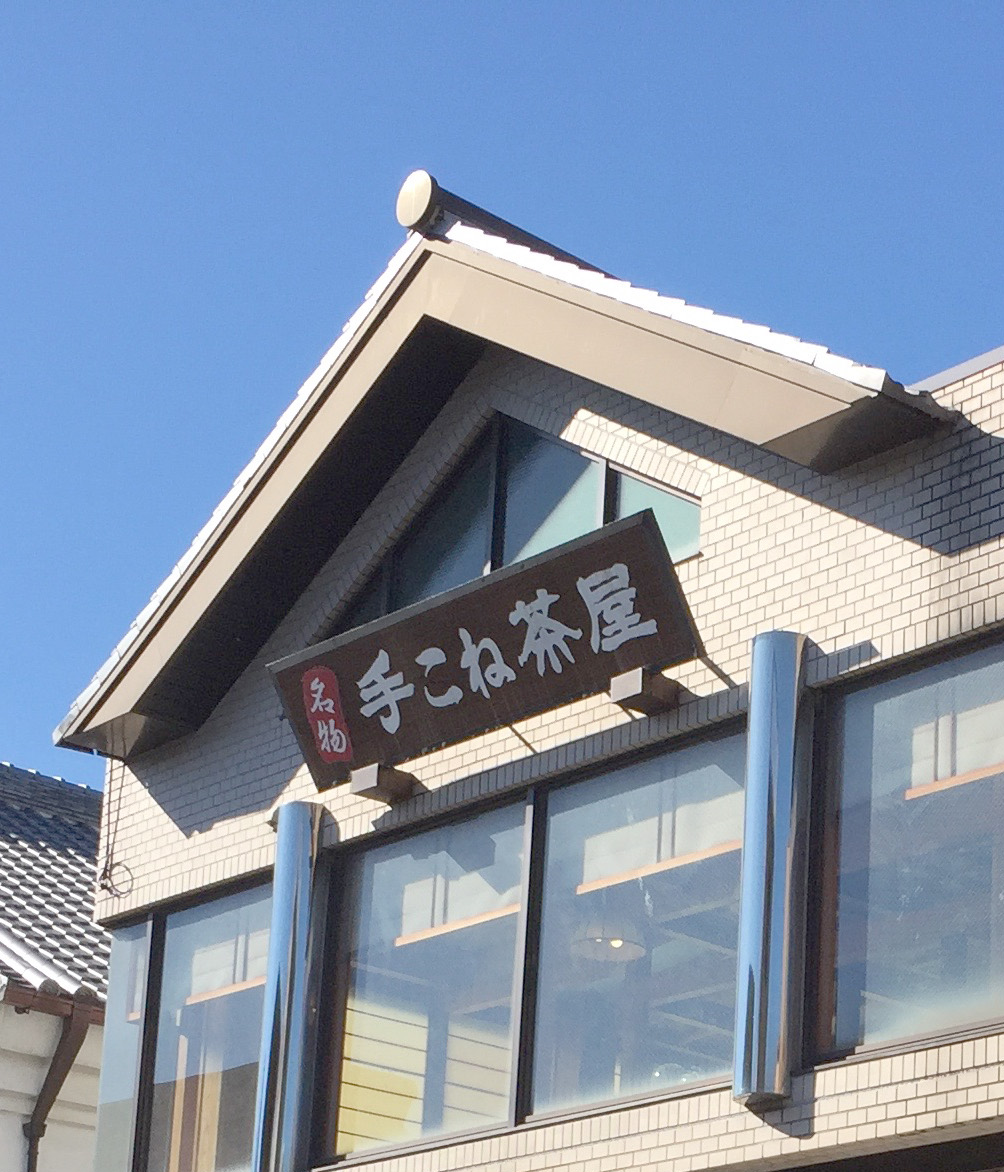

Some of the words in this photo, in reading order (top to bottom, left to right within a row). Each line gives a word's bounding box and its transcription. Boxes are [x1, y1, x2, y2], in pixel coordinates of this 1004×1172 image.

[356, 563, 658, 734] 手こね茶屋
[309, 678, 347, 755] 名物
